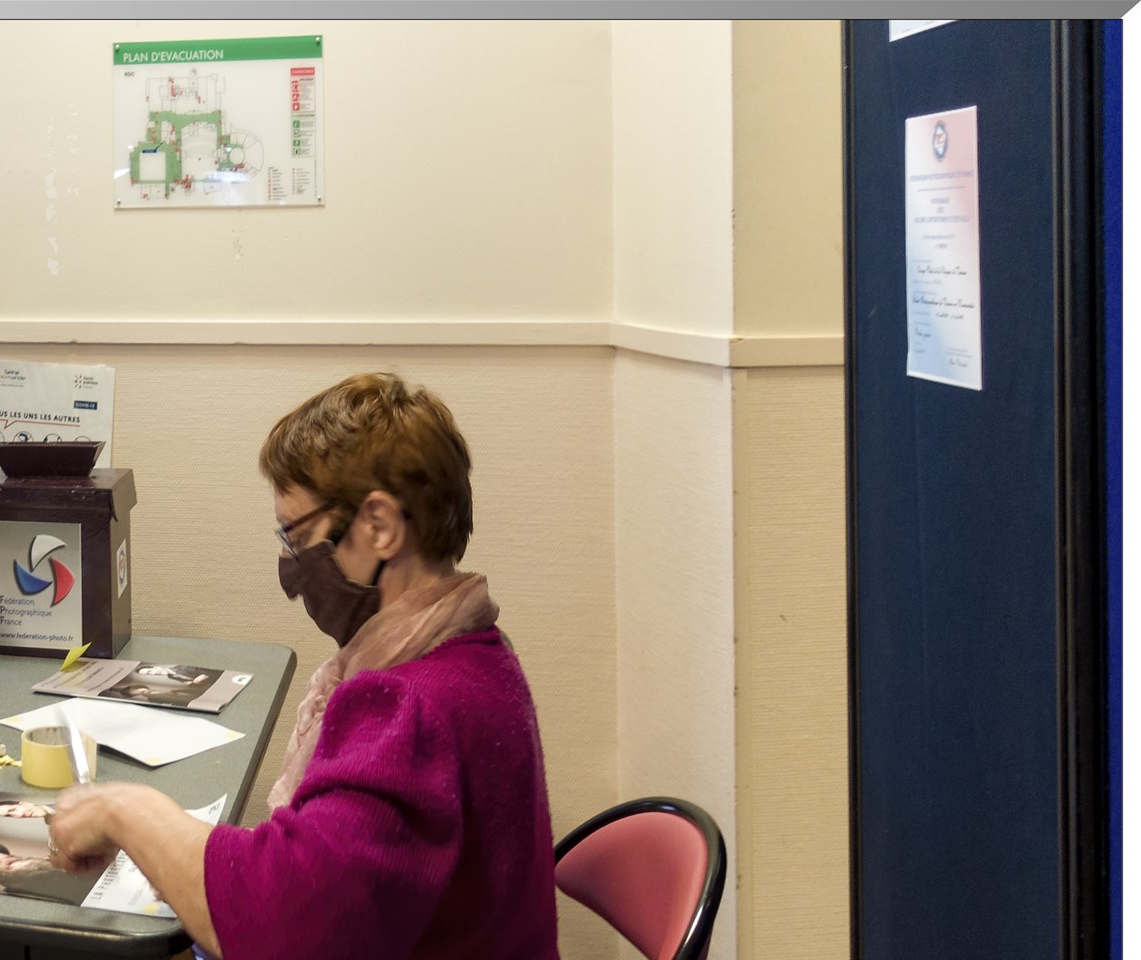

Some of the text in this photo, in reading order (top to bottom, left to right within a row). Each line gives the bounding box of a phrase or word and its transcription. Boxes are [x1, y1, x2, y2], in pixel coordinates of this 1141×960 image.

[123, 49, 224, 63] PLAN D'EVACUATION
[10, 411, 22, 419] LES
[23, 412, 38, 420] UNS
[40, 413, 52, 421] LES
[53, 414, 81, 424] AUTRES
